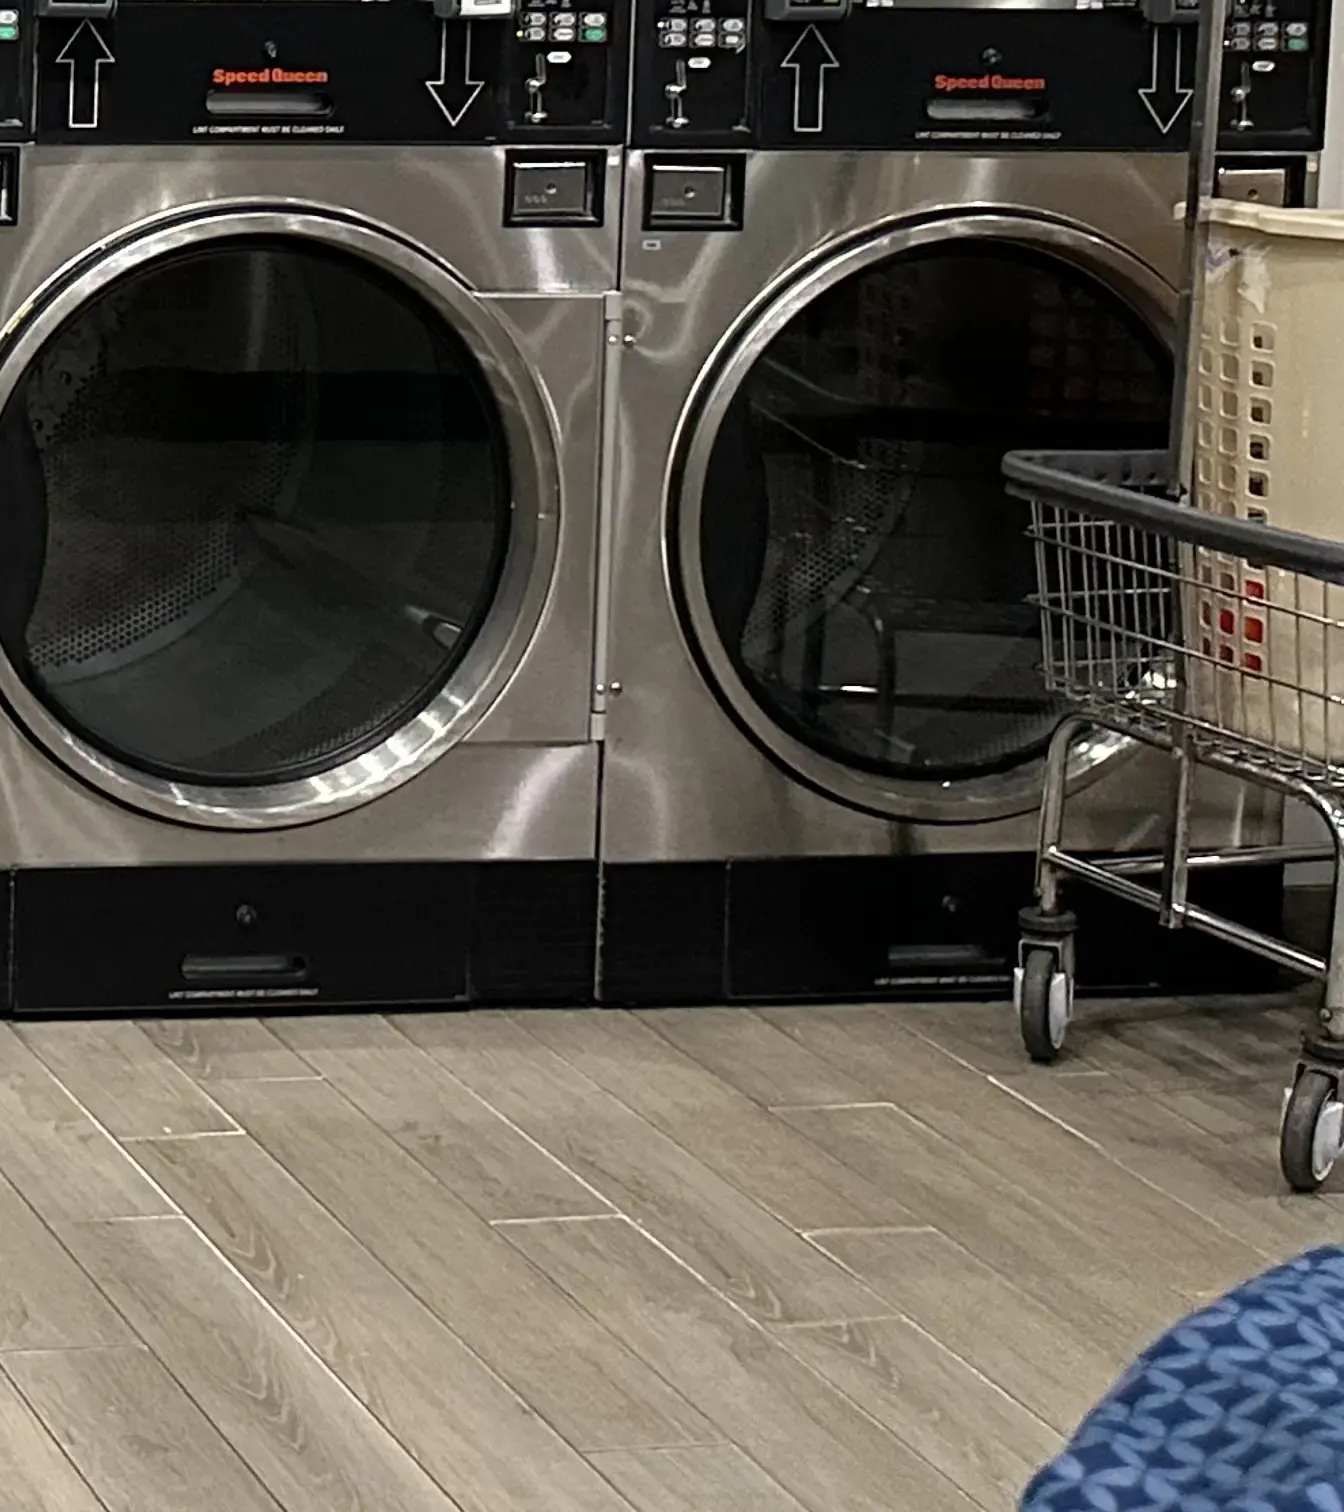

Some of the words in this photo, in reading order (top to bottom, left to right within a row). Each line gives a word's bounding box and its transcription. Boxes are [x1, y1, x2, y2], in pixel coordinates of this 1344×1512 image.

[213, 68, 269, 86] Speed
[272, 68, 328, 83] Queen
[935, 75, 989, 92] Speed
[991, 75, 1045, 90] Queen
